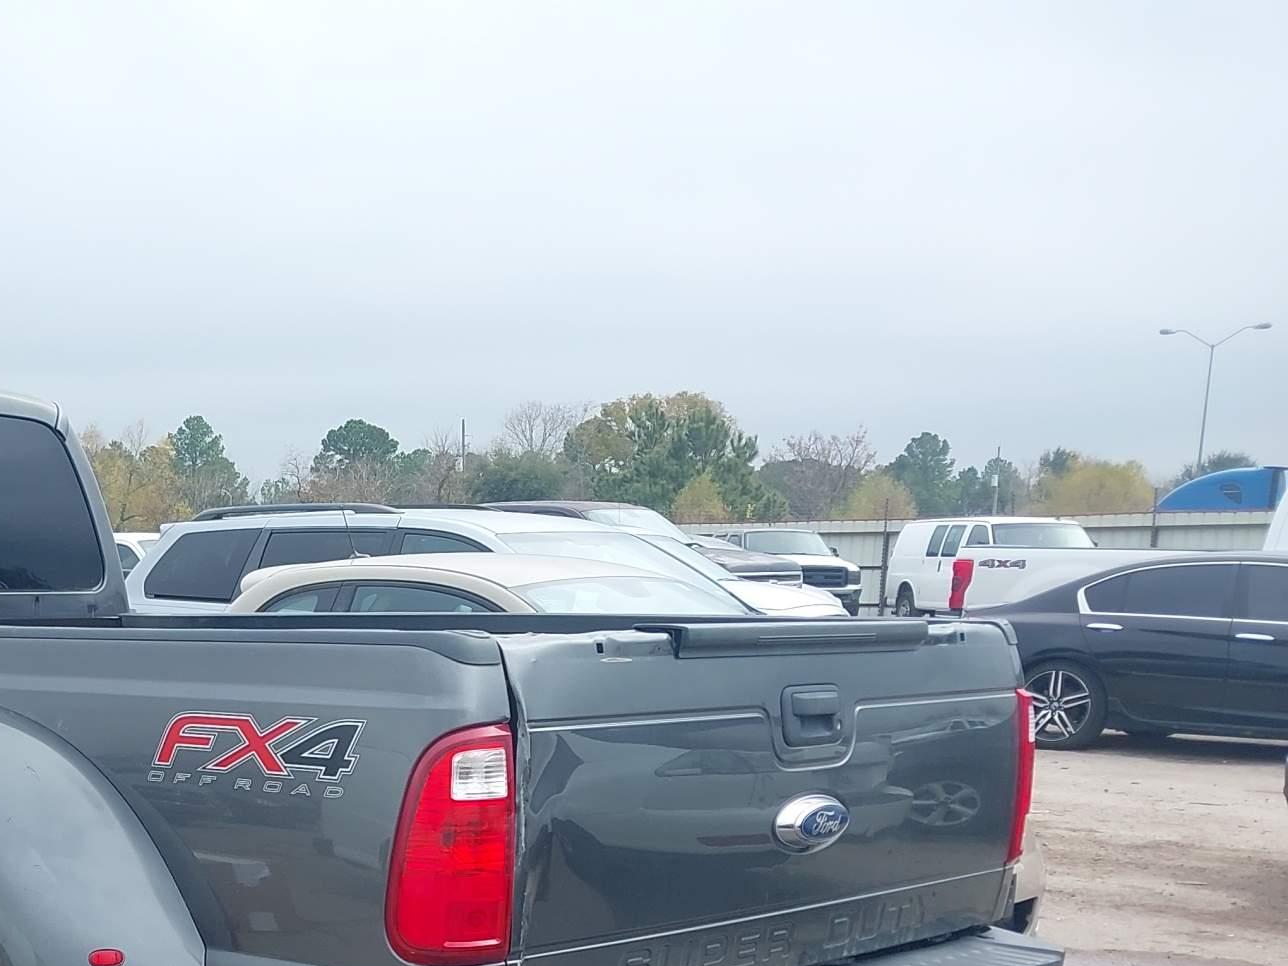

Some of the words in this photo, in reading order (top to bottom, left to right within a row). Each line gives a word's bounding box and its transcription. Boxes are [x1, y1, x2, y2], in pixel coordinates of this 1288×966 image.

[151, 710, 368, 783] FX4
[147, 770, 217, 788] OFF
[233, 778, 345, 799] ROAD
[812, 810, 843, 836] Ford
